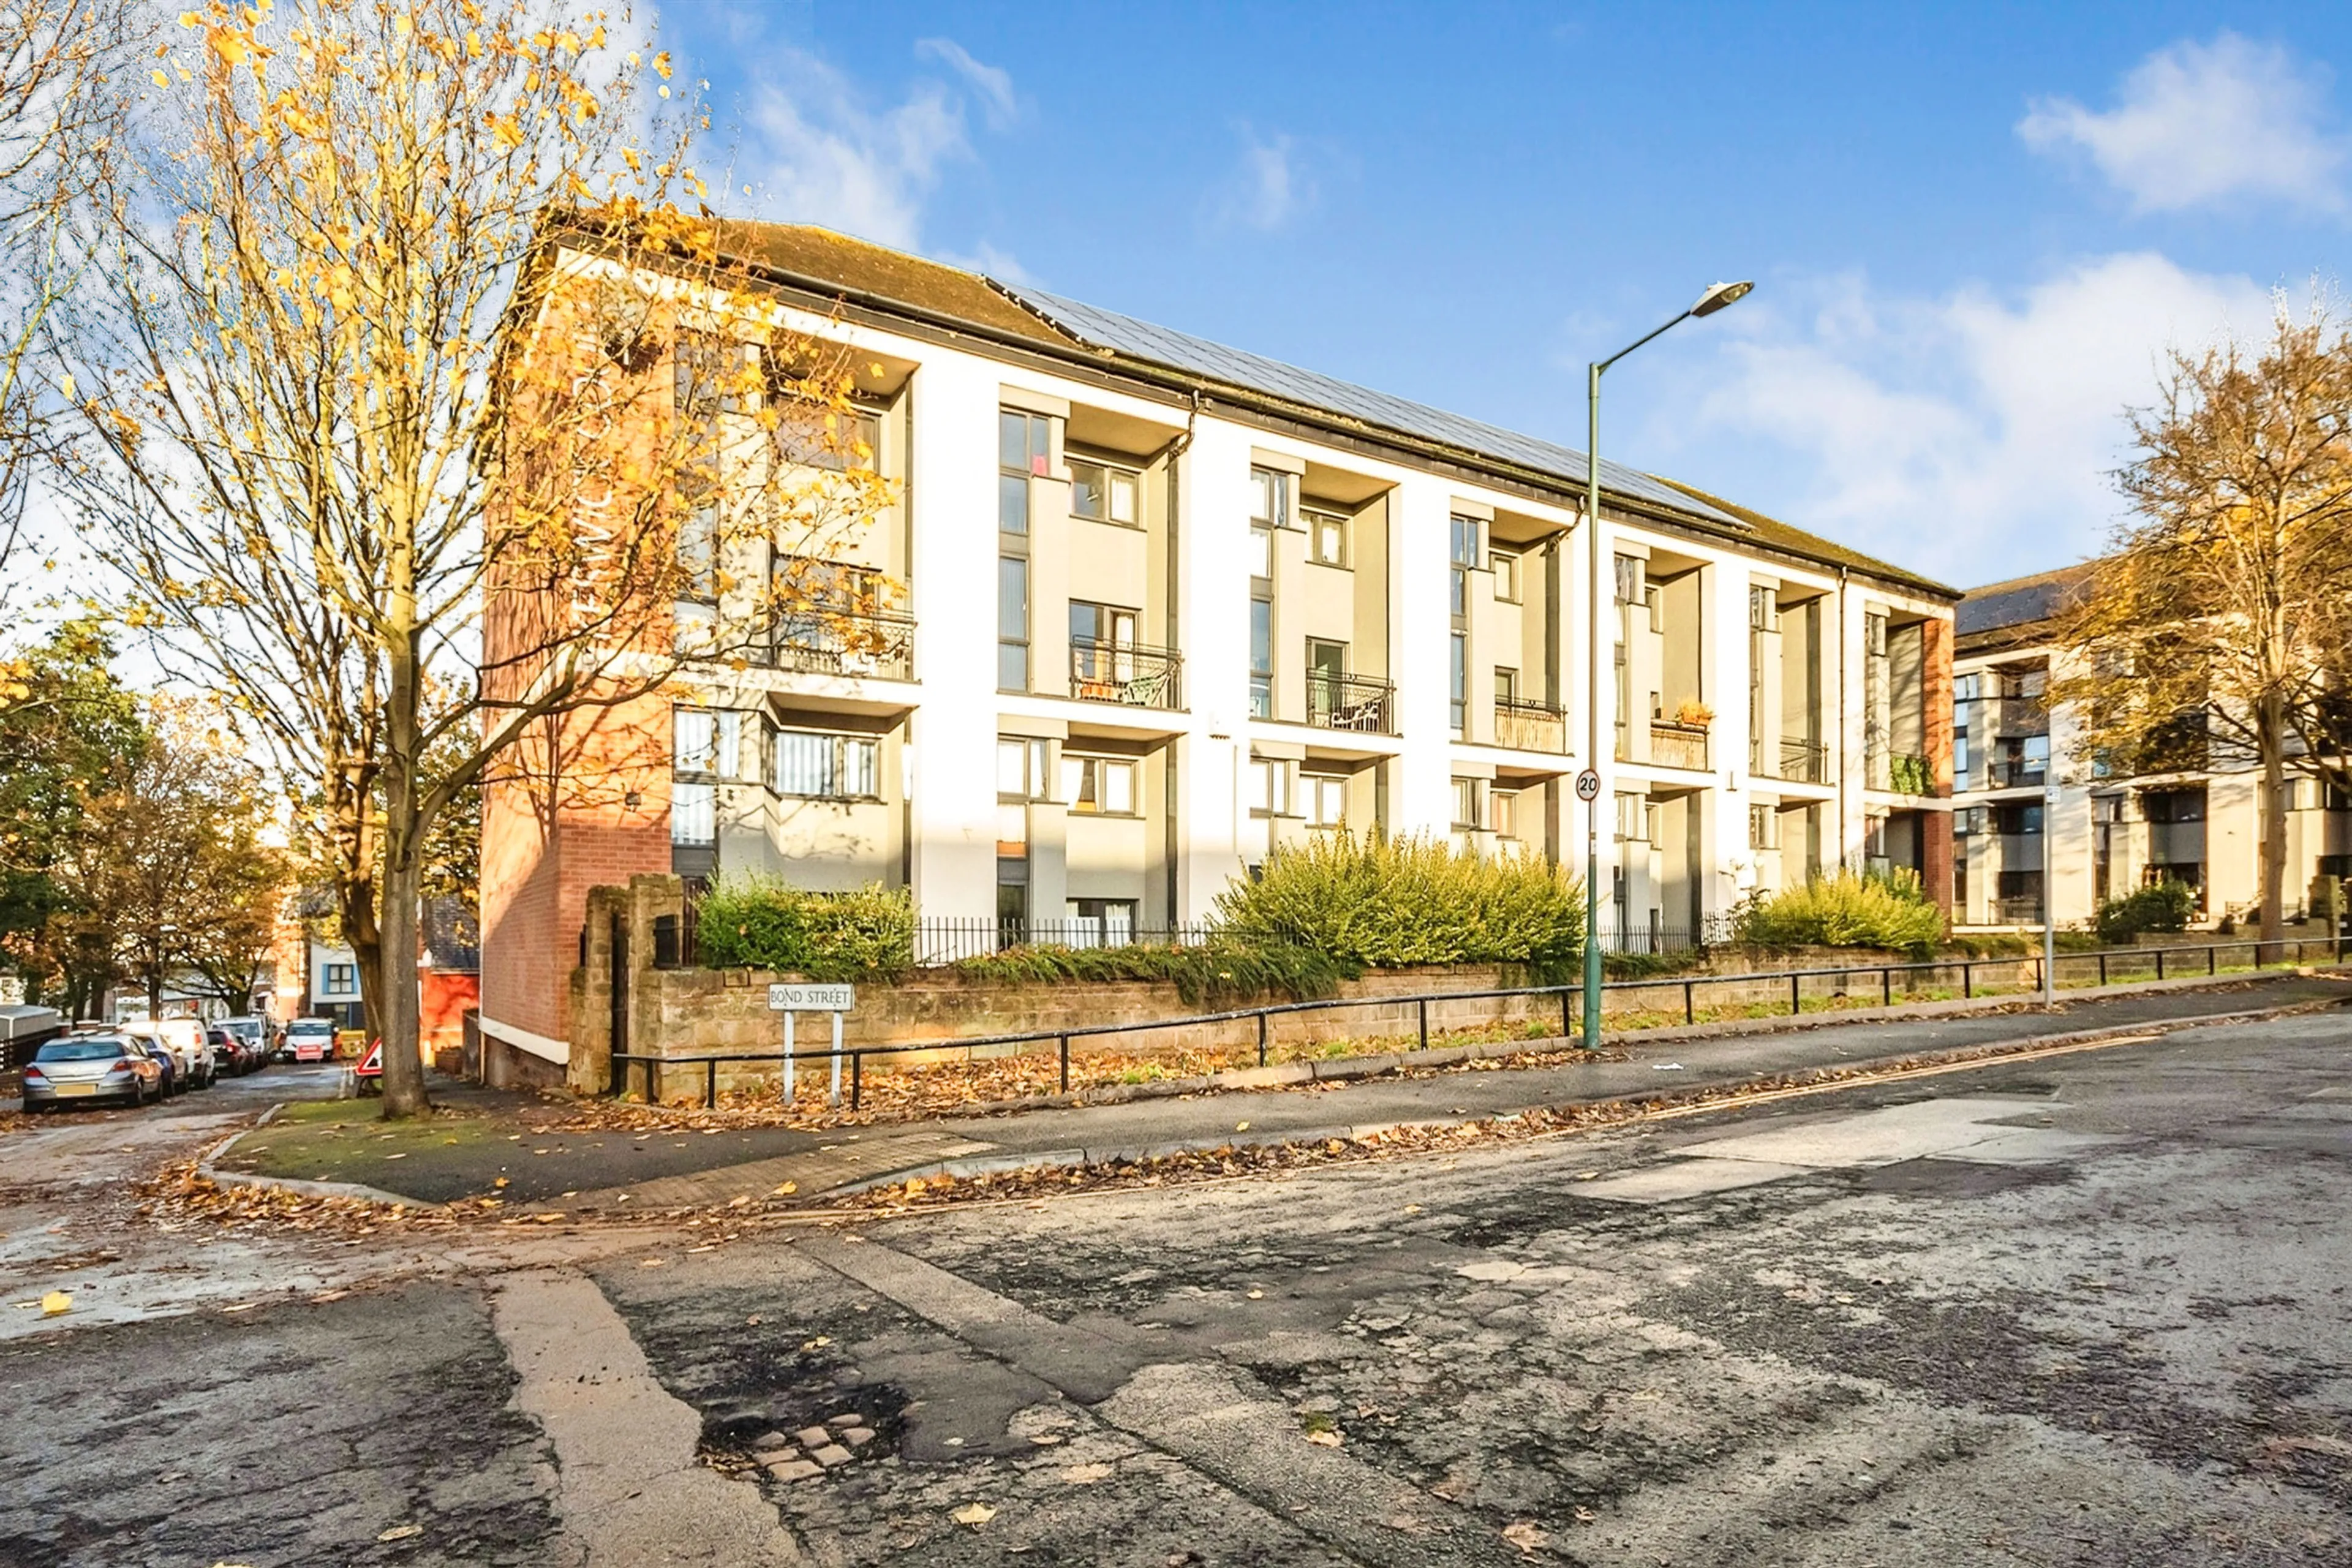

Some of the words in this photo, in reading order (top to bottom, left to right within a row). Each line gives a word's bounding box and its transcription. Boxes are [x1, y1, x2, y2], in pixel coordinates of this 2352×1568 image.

[1580, 777, 1597, 791] 20
[771, 990, 802, 1003] BOND
[808, 990, 849, 1003] STREET
